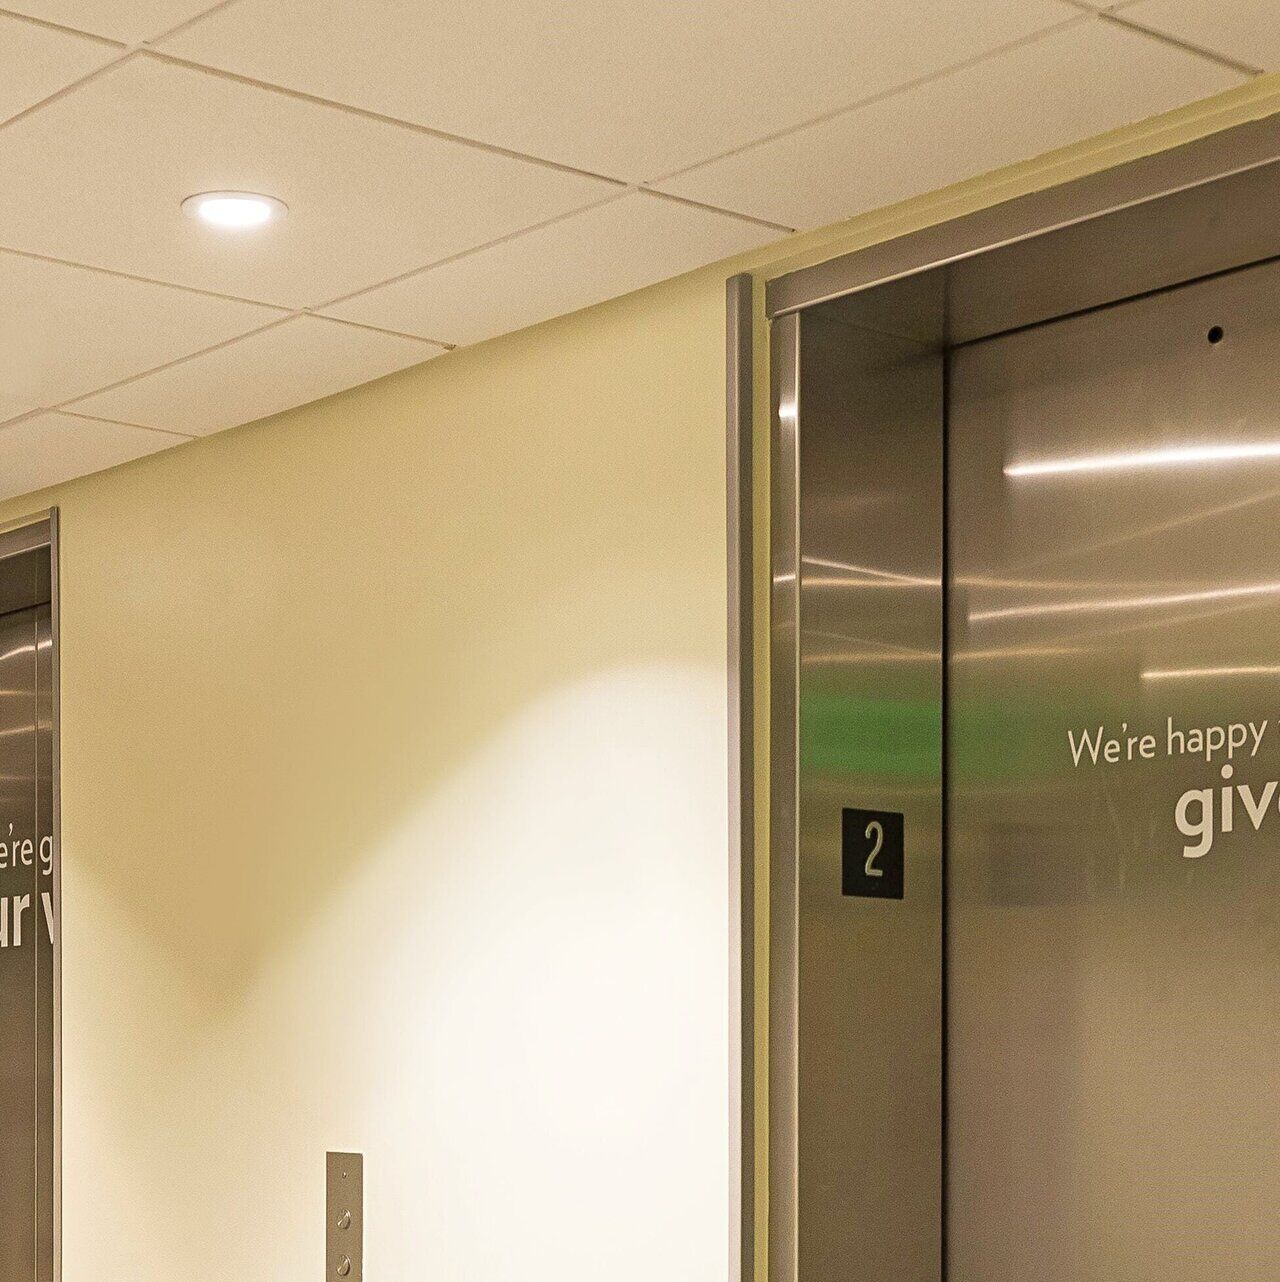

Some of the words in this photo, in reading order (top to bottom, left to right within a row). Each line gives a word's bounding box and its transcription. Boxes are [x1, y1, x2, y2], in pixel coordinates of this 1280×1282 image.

[1068, 722, 1156, 767] We're
[1167, 716, 1268, 762] happy
[865, 821, 883, 876] 2
